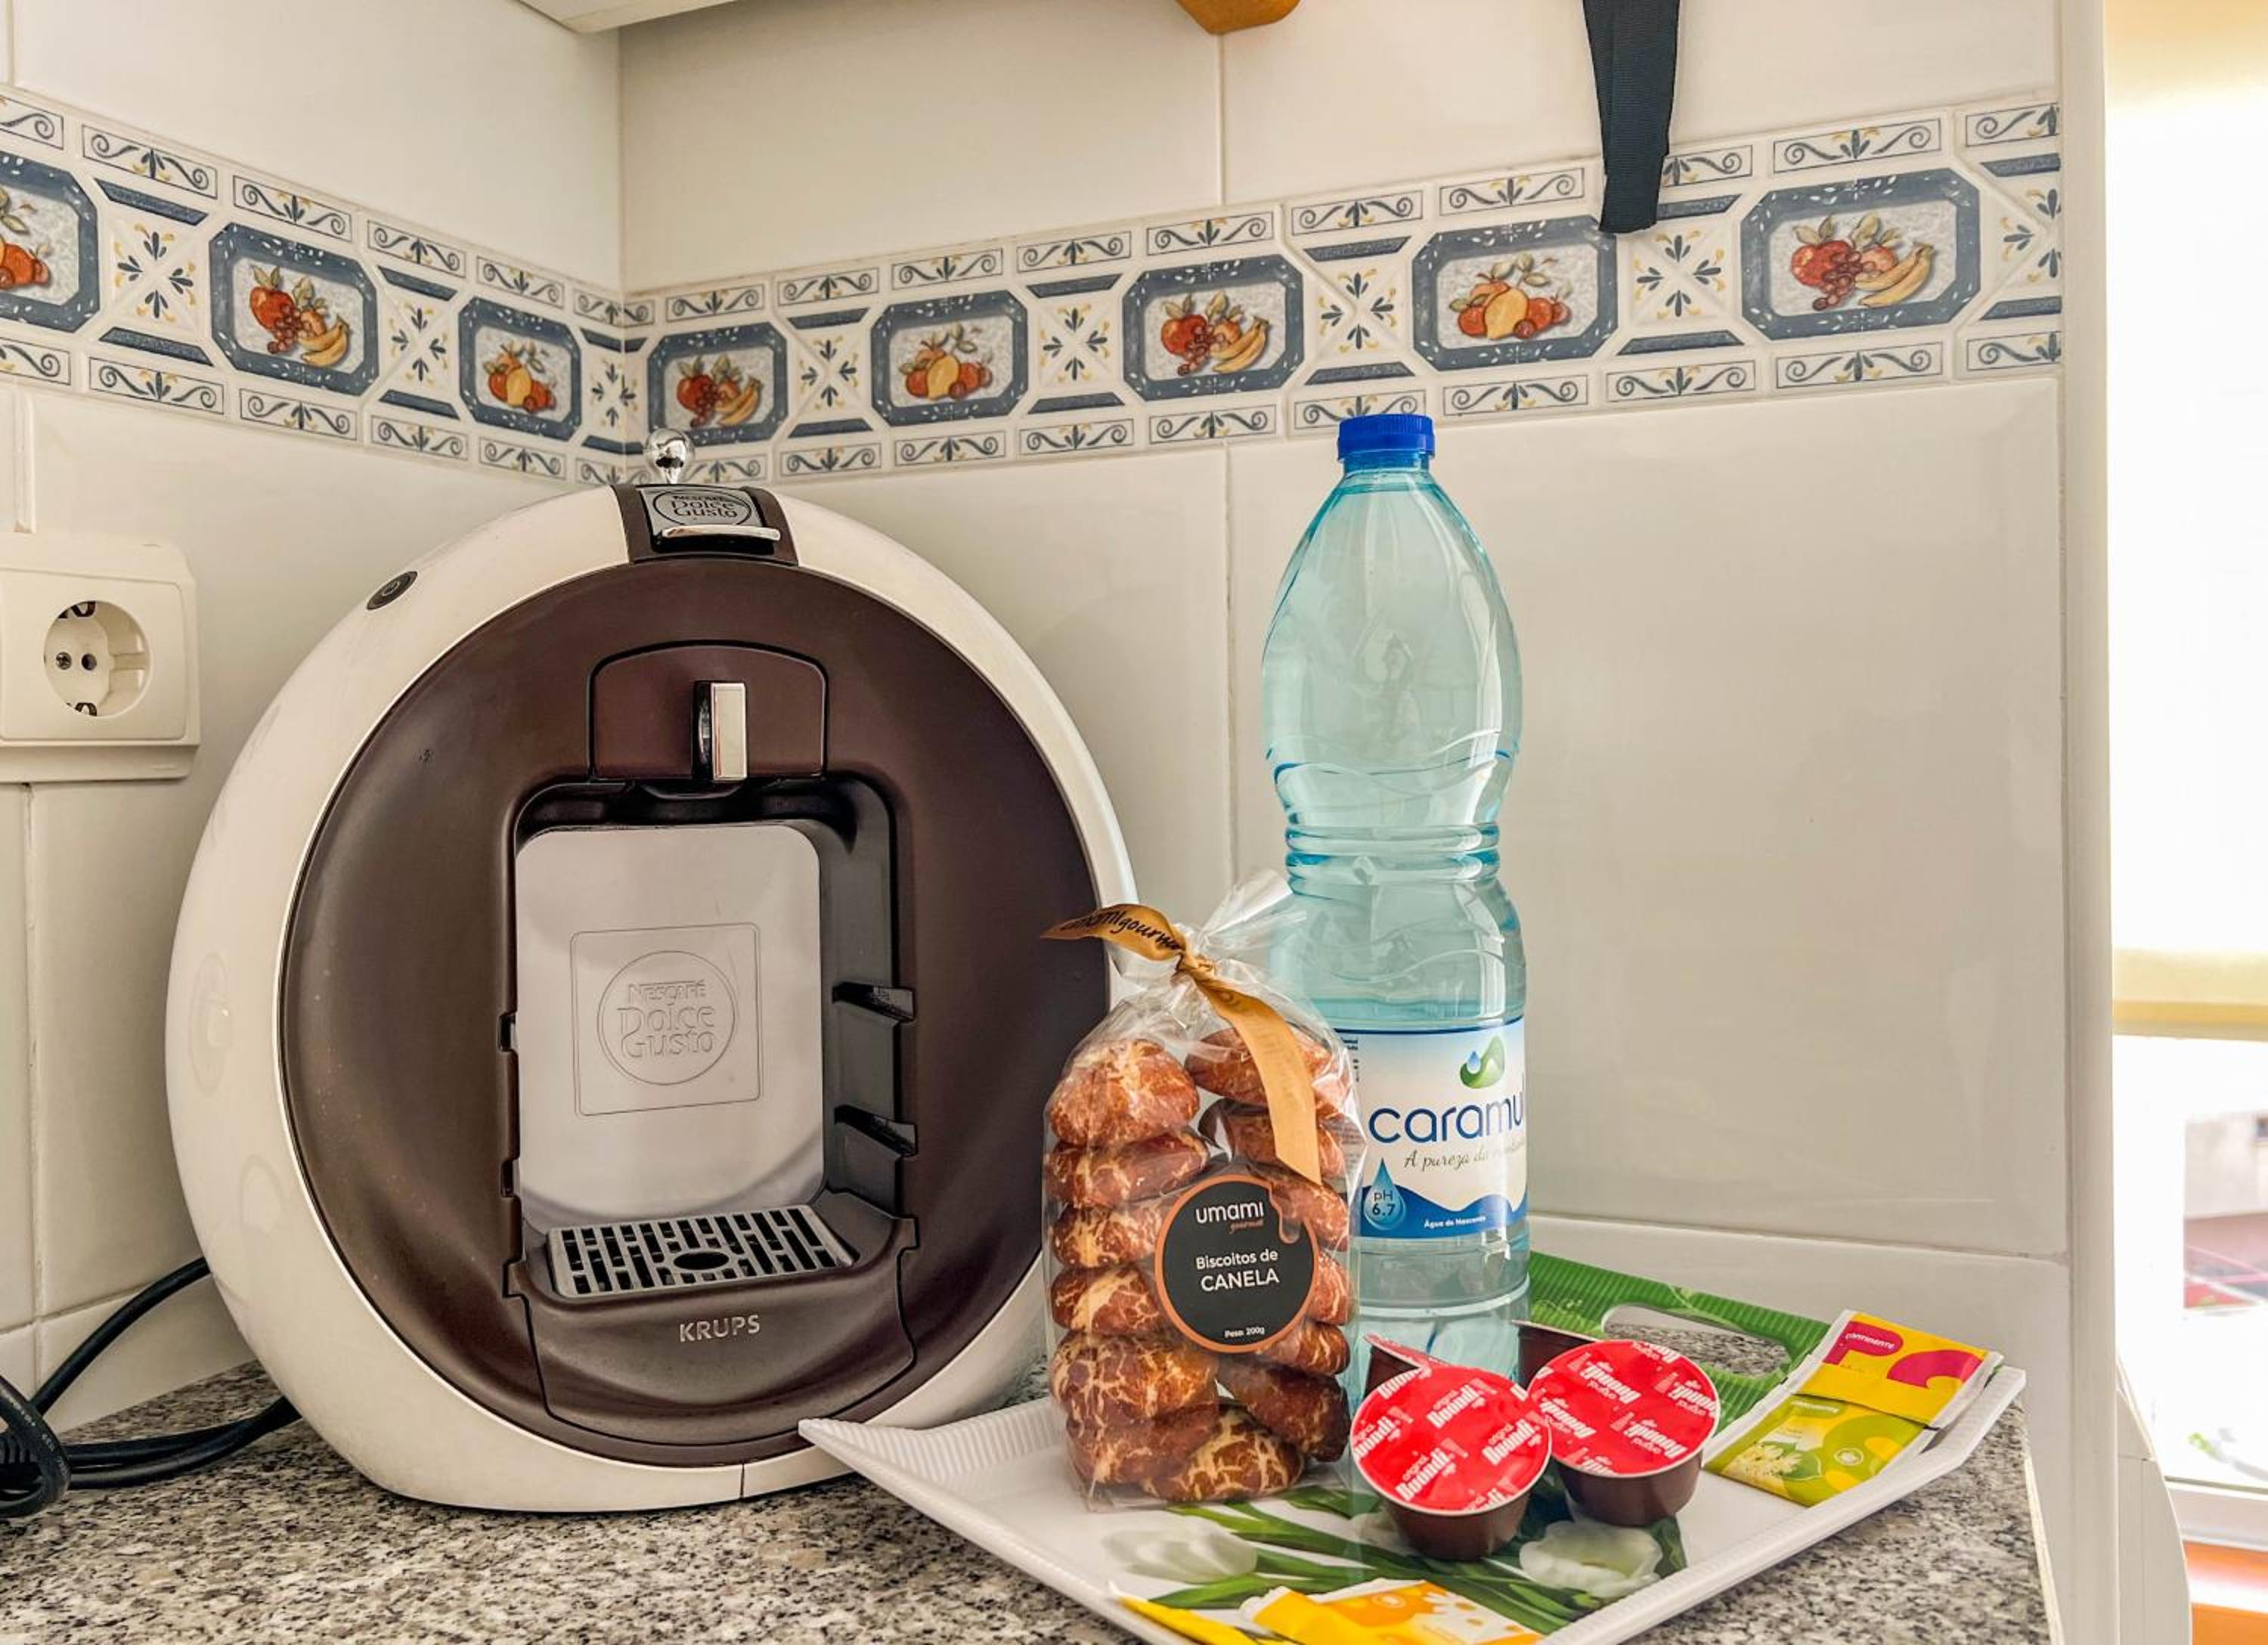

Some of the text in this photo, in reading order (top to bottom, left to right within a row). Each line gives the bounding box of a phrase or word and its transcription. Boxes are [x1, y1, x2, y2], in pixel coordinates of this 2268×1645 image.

[671, 500, 736, 510] Dolce
[674, 507, 738, 518] Gusto
[1368, 1073, 1524, 1144] caramu
[1404, 1150, 1418, 1168] A
[1373, 1191, 1394, 1202] pH
[1196, 1201, 1264, 1223] umami
[1371, 1202, 1396, 1217] 6.7
[1196, 1248, 1279, 1271] Biscoitos de
[1201, 1268, 1281, 1293] CANELA
[680, 1314, 761, 1343] KRUPS
